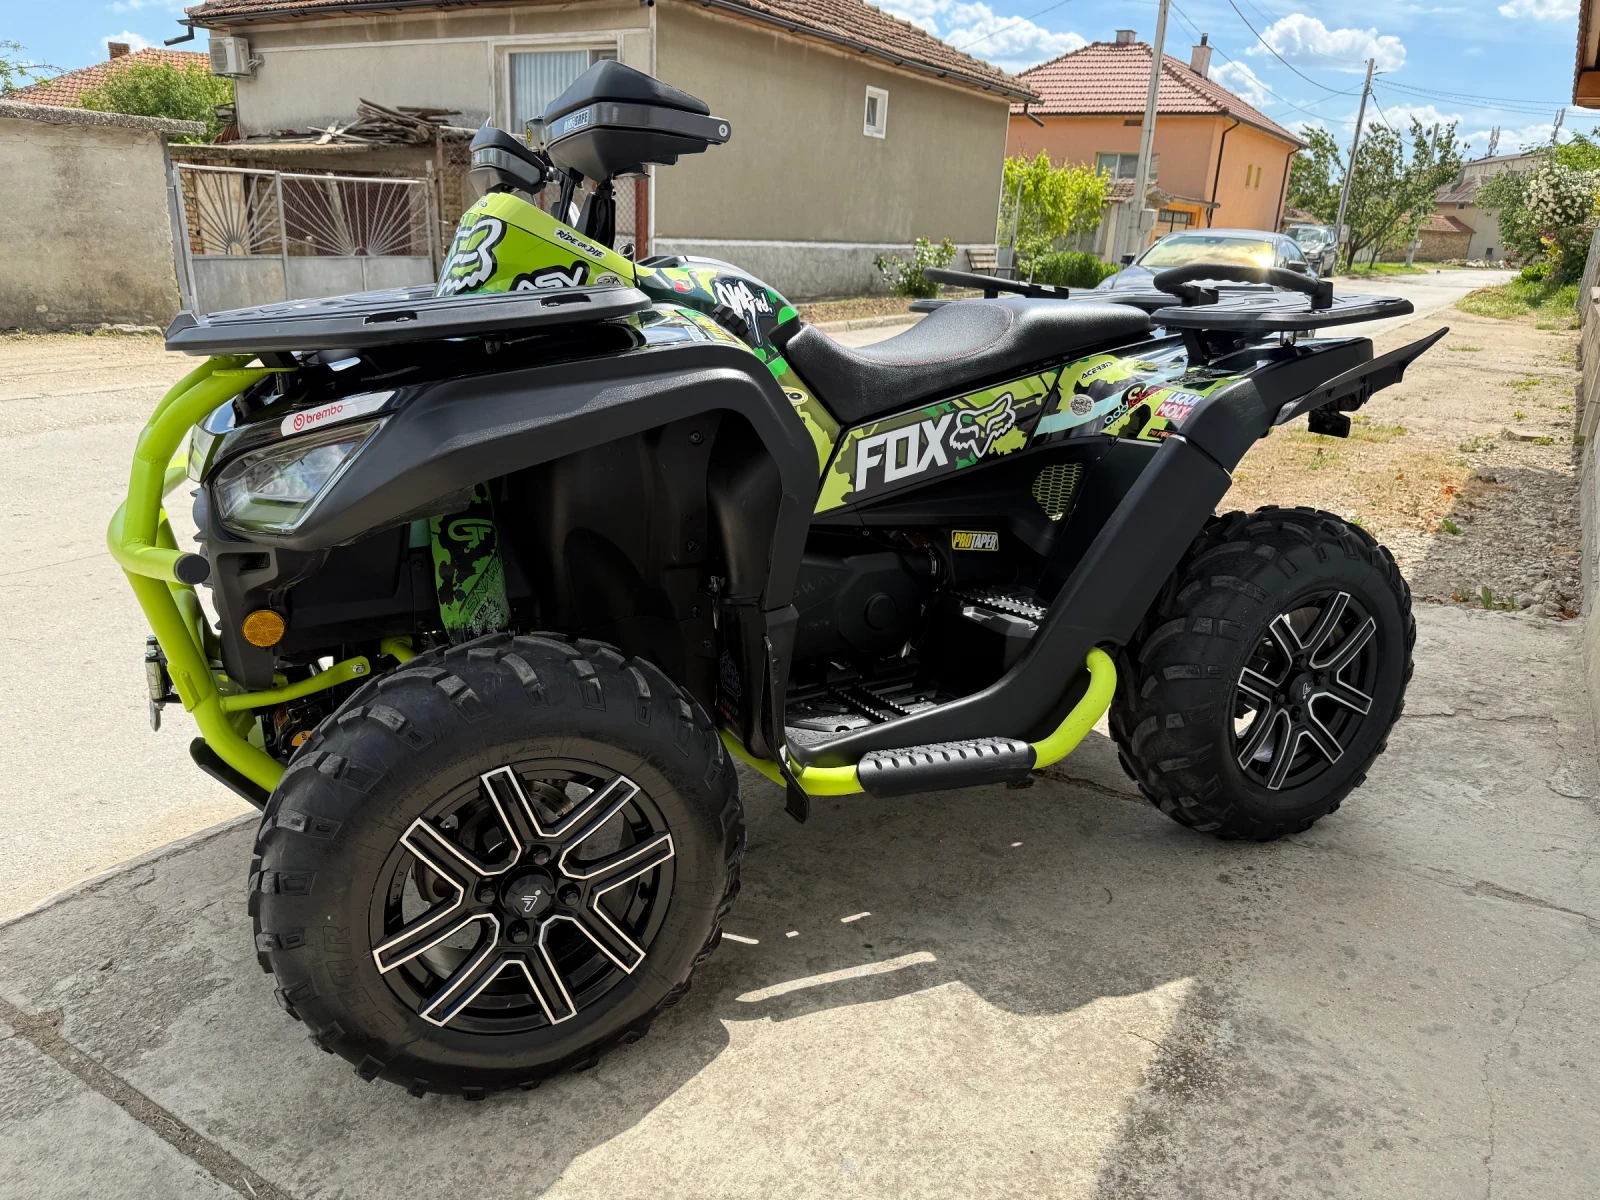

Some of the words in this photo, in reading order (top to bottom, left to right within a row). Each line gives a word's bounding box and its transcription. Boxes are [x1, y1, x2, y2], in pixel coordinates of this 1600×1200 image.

[556, 228, 579, 245] RIDE
[585, 245, 605, 258] DIE
[516, 266, 584, 291] ASV
[1081, 361, 1114, 380] ACERBIS
[306, 404, 344, 425] brembo
[1155, 403, 1193, 420] MOLY
[855, 414, 954, 493] FOX
